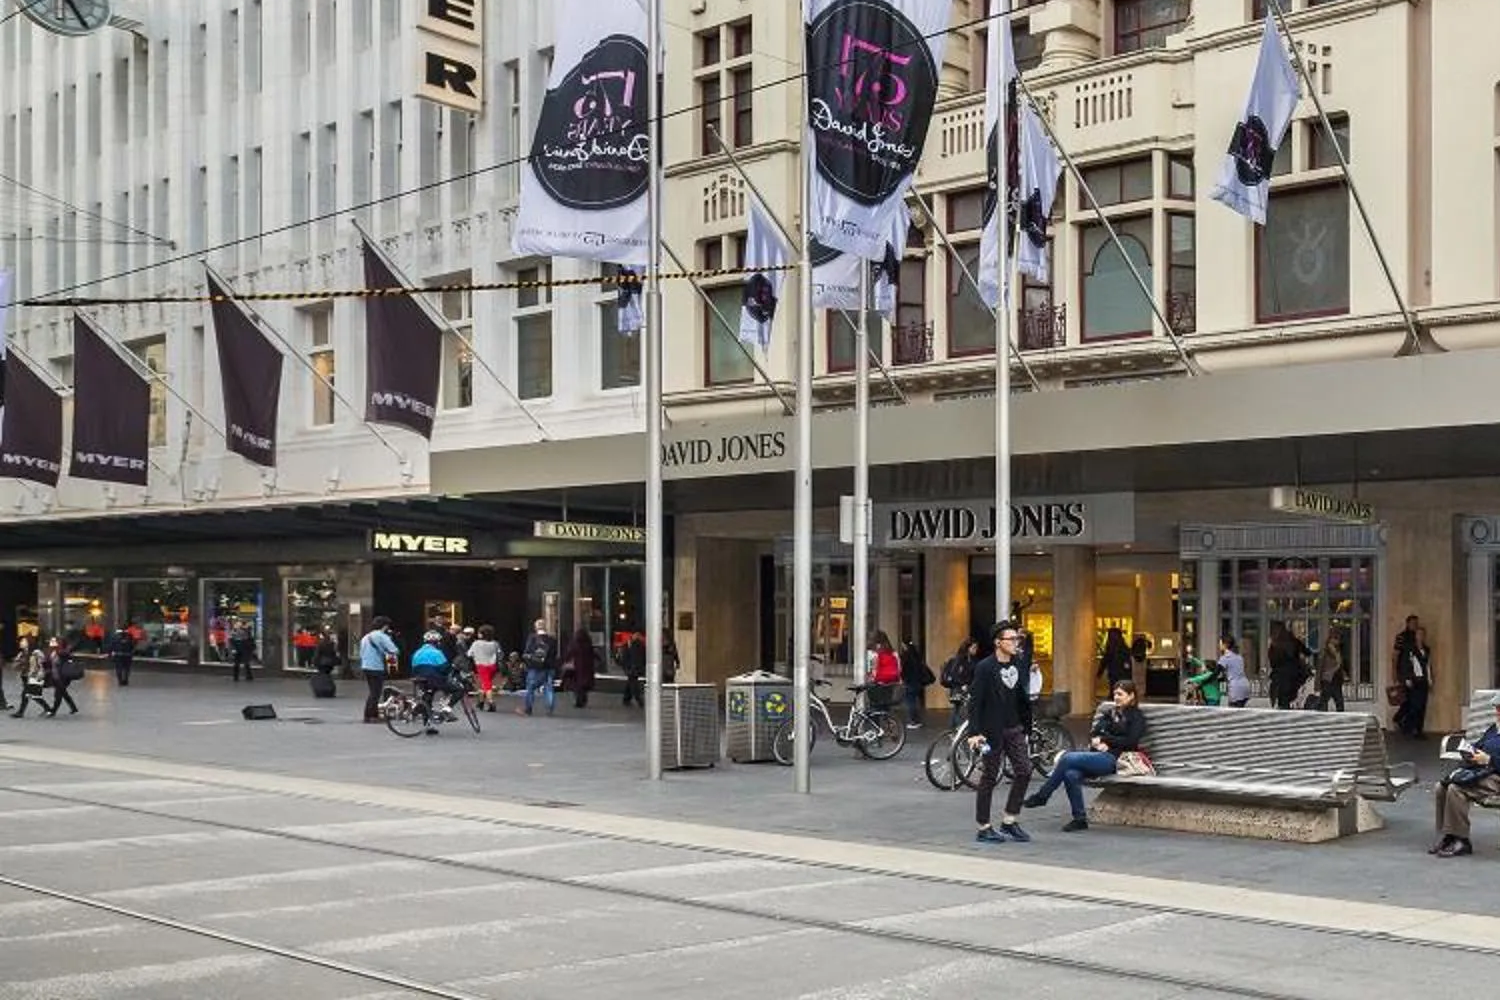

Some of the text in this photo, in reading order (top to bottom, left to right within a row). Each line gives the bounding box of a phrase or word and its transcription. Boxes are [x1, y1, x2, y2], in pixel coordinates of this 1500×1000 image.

[371, 390, 436, 418] MYER
[717, 431, 785, 462] JONES
[2, 453, 60, 473] MYER
[76, 452, 146, 471] MYER
[1295, 490, 1333, 512] DAVID
[554, 523, 601, 538] DAVID
[891, 508, 977, 541] DAVID
[374, 531, 469, 553] MYER
